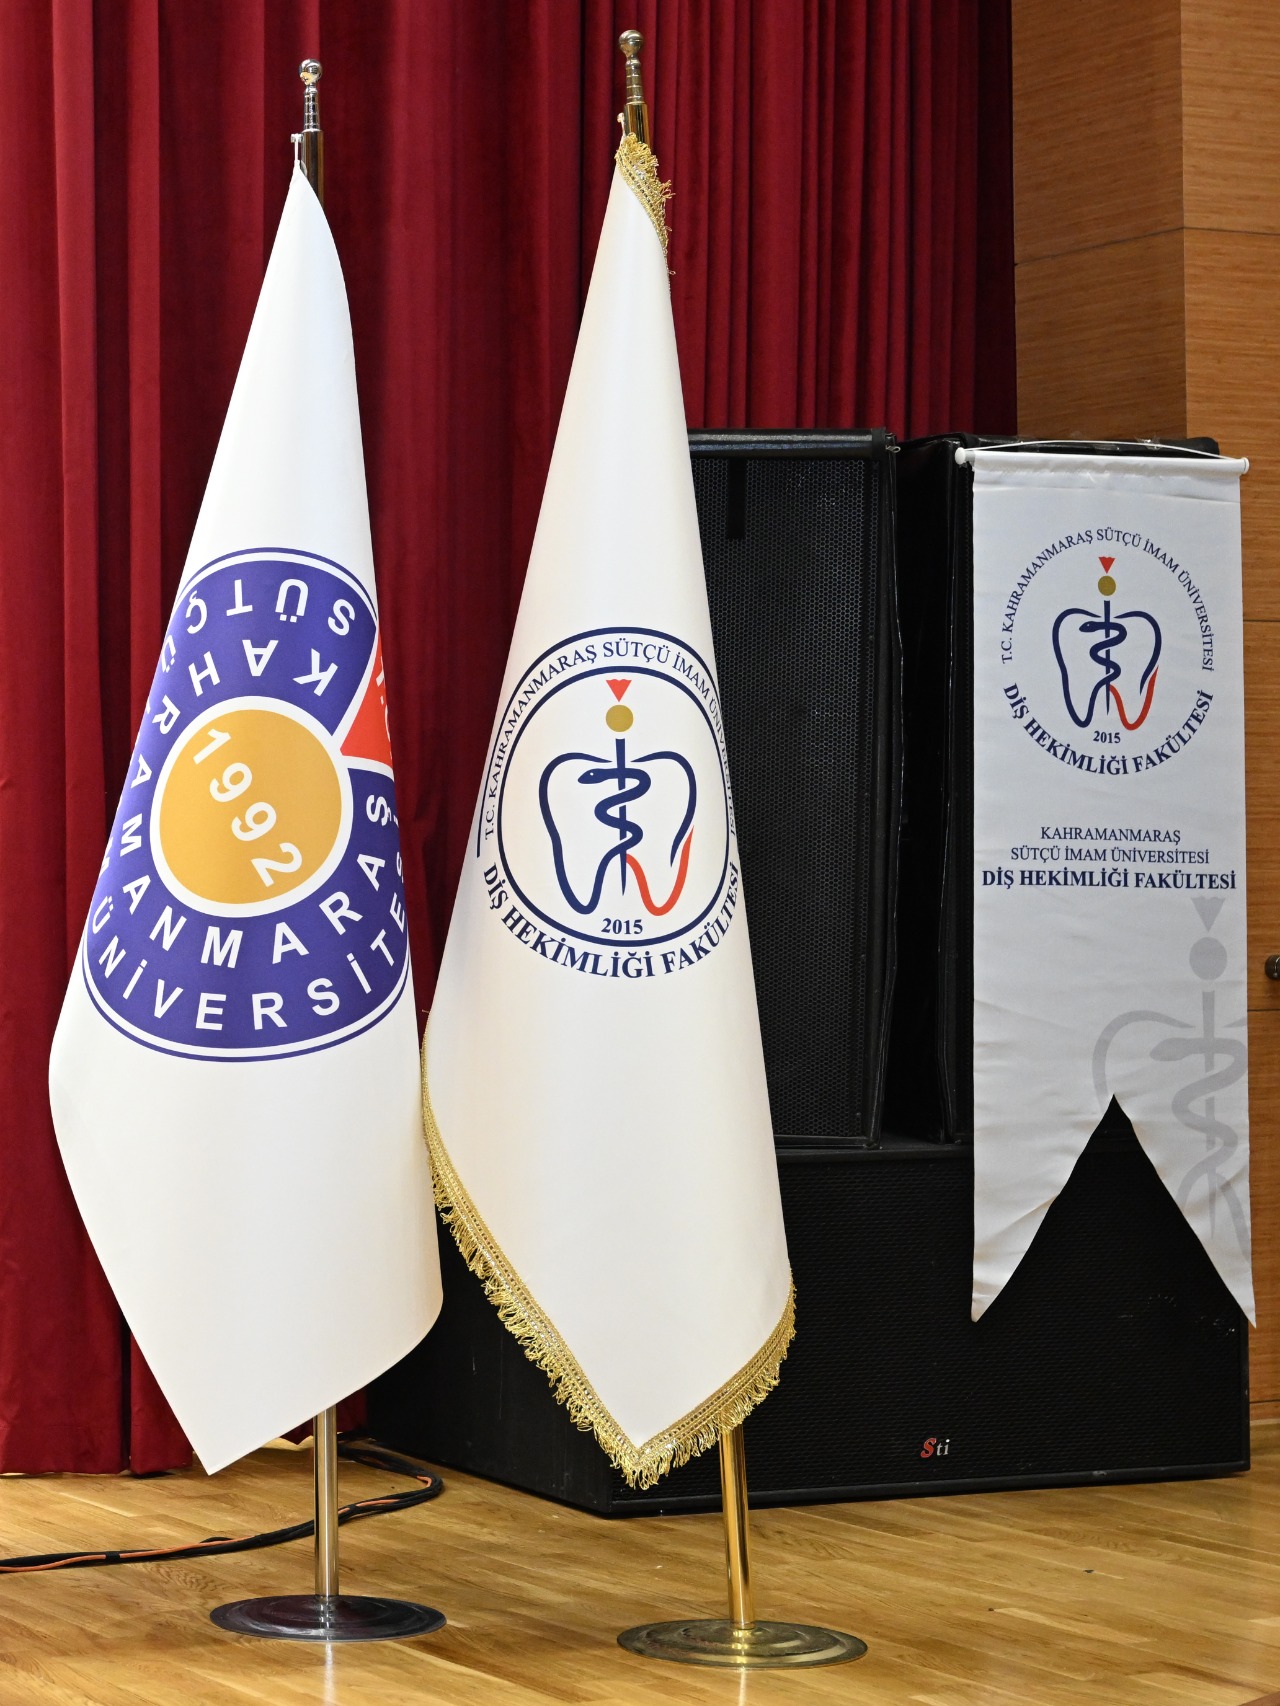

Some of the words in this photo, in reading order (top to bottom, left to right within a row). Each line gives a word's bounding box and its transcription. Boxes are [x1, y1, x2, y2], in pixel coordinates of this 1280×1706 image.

[1096, 526, 1142, 548] SÜTÇÜ
[1143, 538, 1179, 574] İMAM
[1001, 530, 1093, 634] KAHRAMANMARAŞ
[1177, 570, 1214, 672] ÜNİVERSİTESİ
[602, 637, 671, 664] SÜTÇÜ
[1001, 636, 1013, 665] T.C.
[672, 651, 711, 701] İMAM
[488, 644, 598, 799] KAHRAMANMARAŞ
[1003, 683, 1030, 720] DİŞ
[1023, 717, 1129, 776] HEKİMLİĞİ
[1132, 689, 1214, 773] FAKÜLTESİ
[1092, 730, 1122, 744] 2015
[120, 639, 392, 969] KAHRAMANMARAŞ
[192, 728, 304, 888] 1992
[484, 803, 496, 841] T.C.
[1011, 845, 1061, 864] SÜTÇÜ
[1064, 845, 1107, 863] İMAM
[1111, 846, 1210, 864] ÜNİVERSİTESİ
[1041, 826, 1181, 846] KAHRAMANMARAŞ
[982, 866, 1015, 890] DİŞ
[1019, 866, 1129, 888] HEKİMLİĞİ
[1134, 869, 1237, 890] FAKÜLTESİ
[90, 815, 406, 1031] ÜNİVERSİTES
[483, 862, 509, 910] DİŞ
[501, 904, 656, 978] HEKİMLİĞİ
[660, 861, 739, 975] FAKÜLTESİ
[601, 917, 644, 935] 2015
[920, 1437, 951, 1458] Sti
